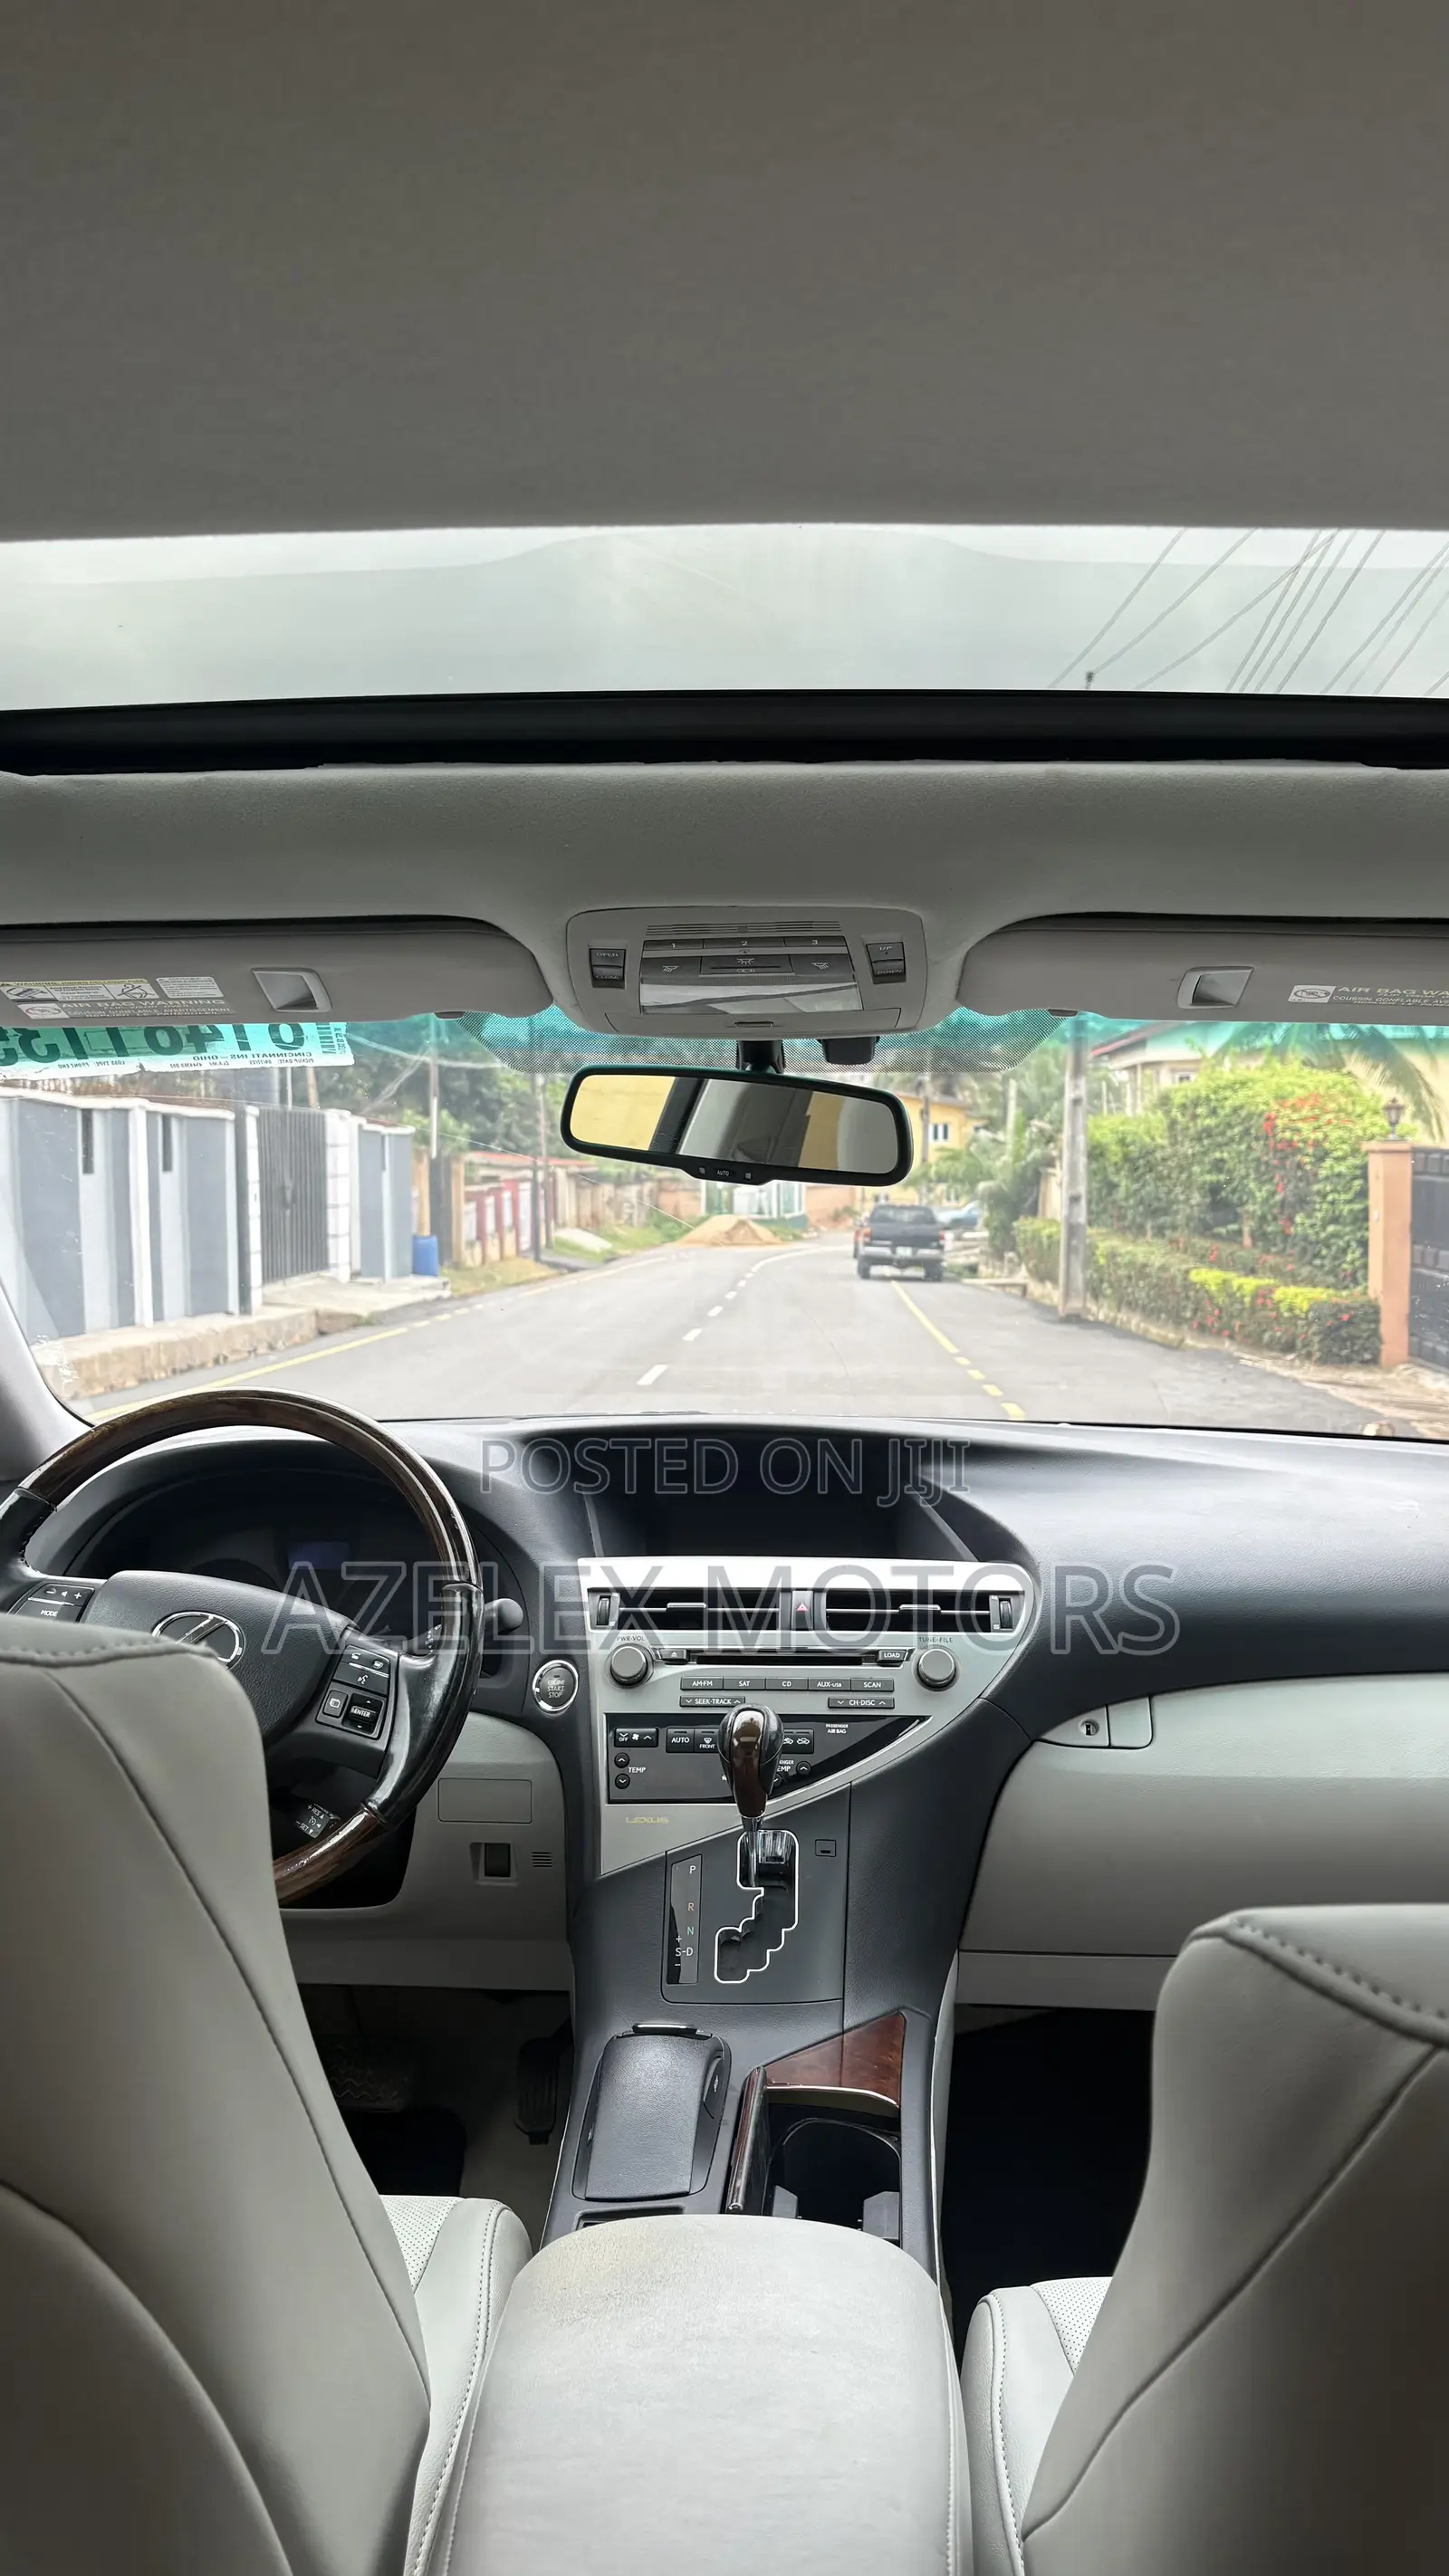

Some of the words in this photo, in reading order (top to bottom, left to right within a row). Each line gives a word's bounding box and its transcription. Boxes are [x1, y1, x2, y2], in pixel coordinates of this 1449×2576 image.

[40, 1609, 59, 1617] MODE
[353, 1708, 370, 1718] ENTER
[689, 1865, 696, 1874] P
[687, 1902, 695, 1911] R
[687, 1926, 695, 1935] N
